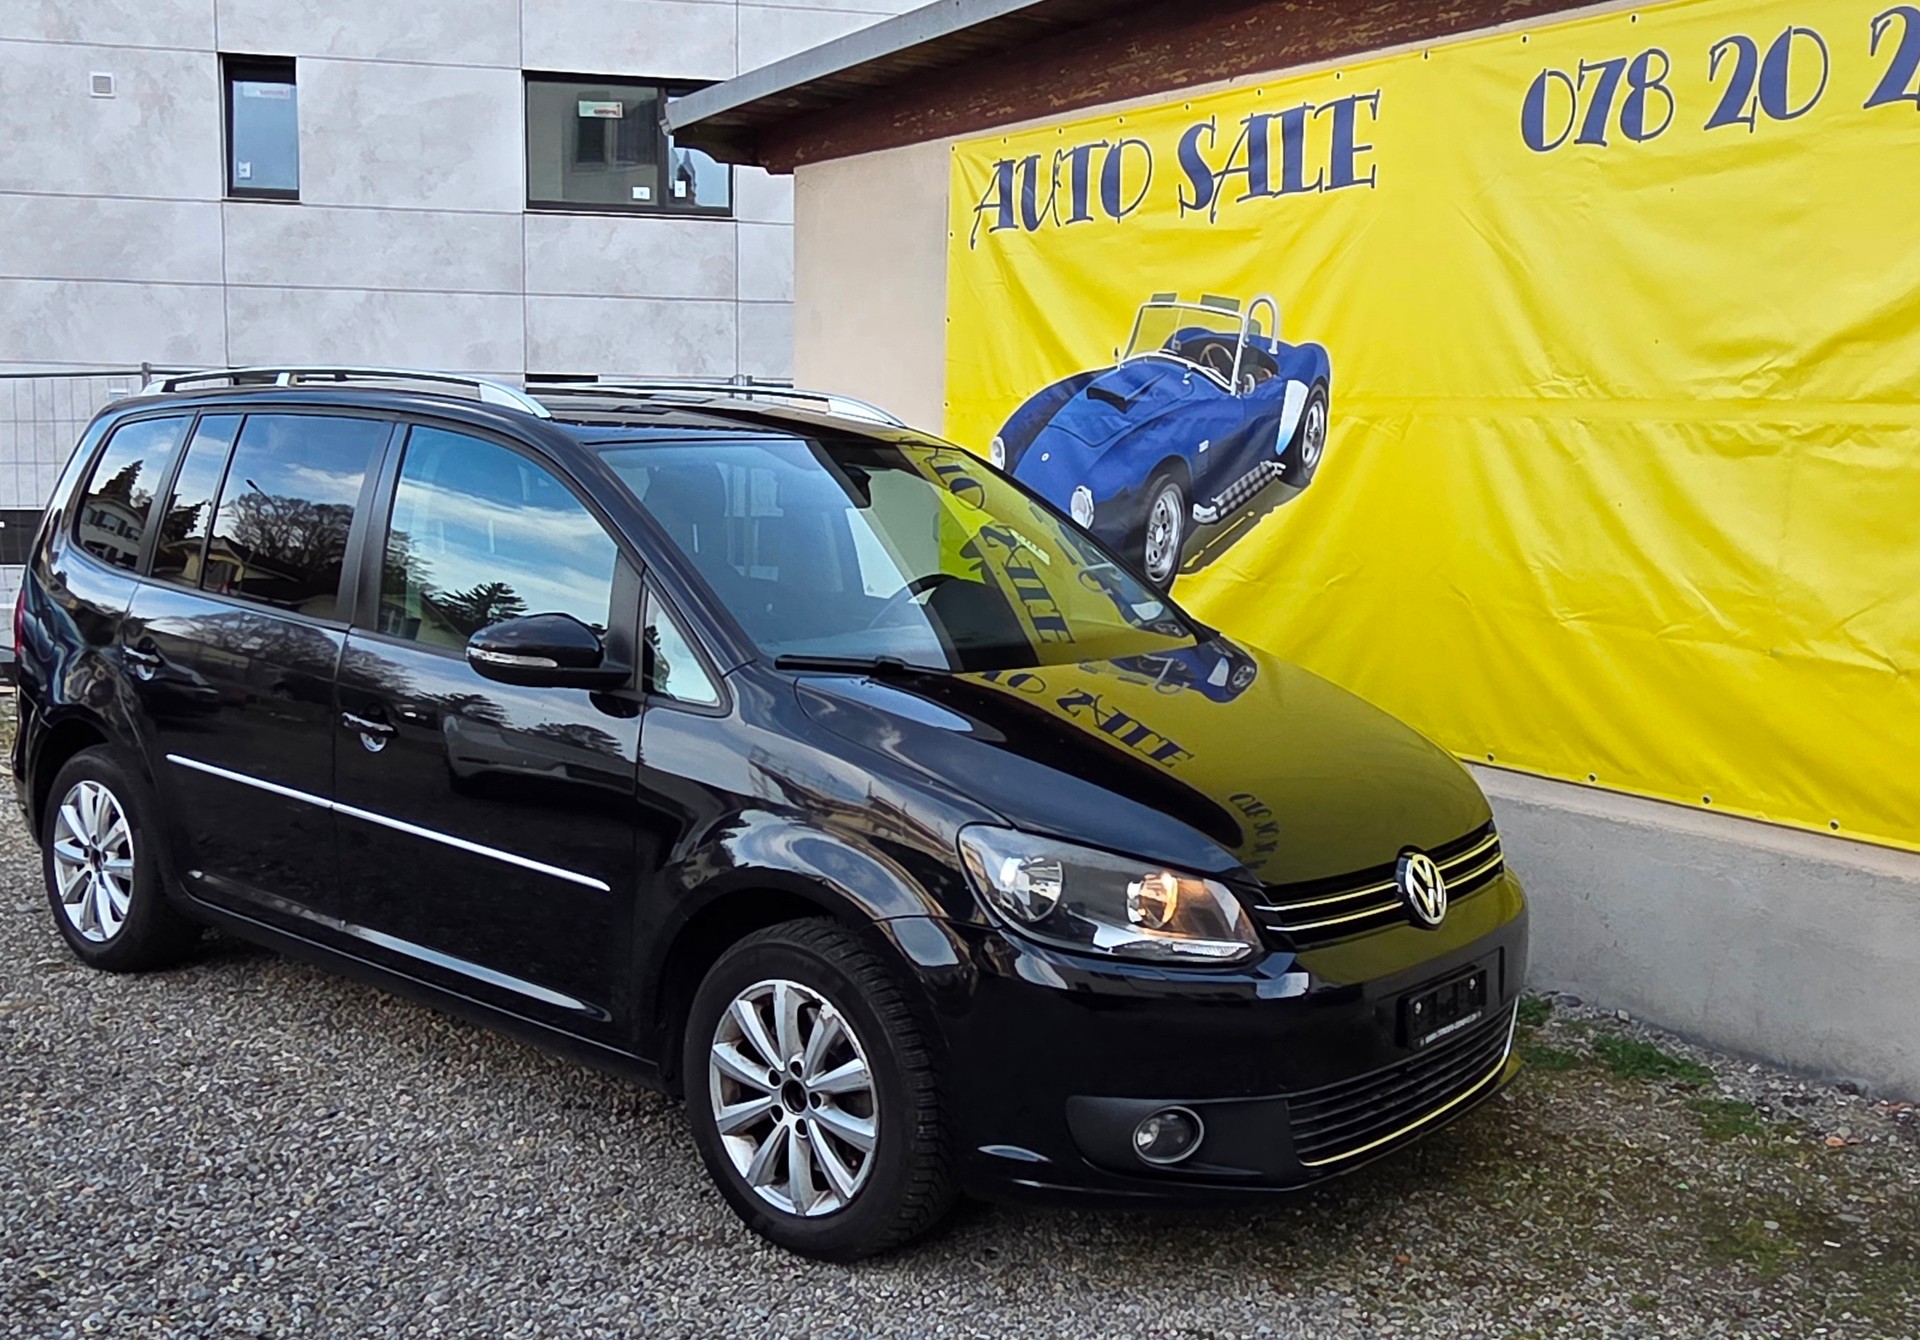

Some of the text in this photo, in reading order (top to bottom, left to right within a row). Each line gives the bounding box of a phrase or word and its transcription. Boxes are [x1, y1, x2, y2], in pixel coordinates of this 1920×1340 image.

[1520, 47, 1674, 153] 078
[1703, 26, 1829, 134] 20
[971, 89, 1381, 250] AUTO SALE
